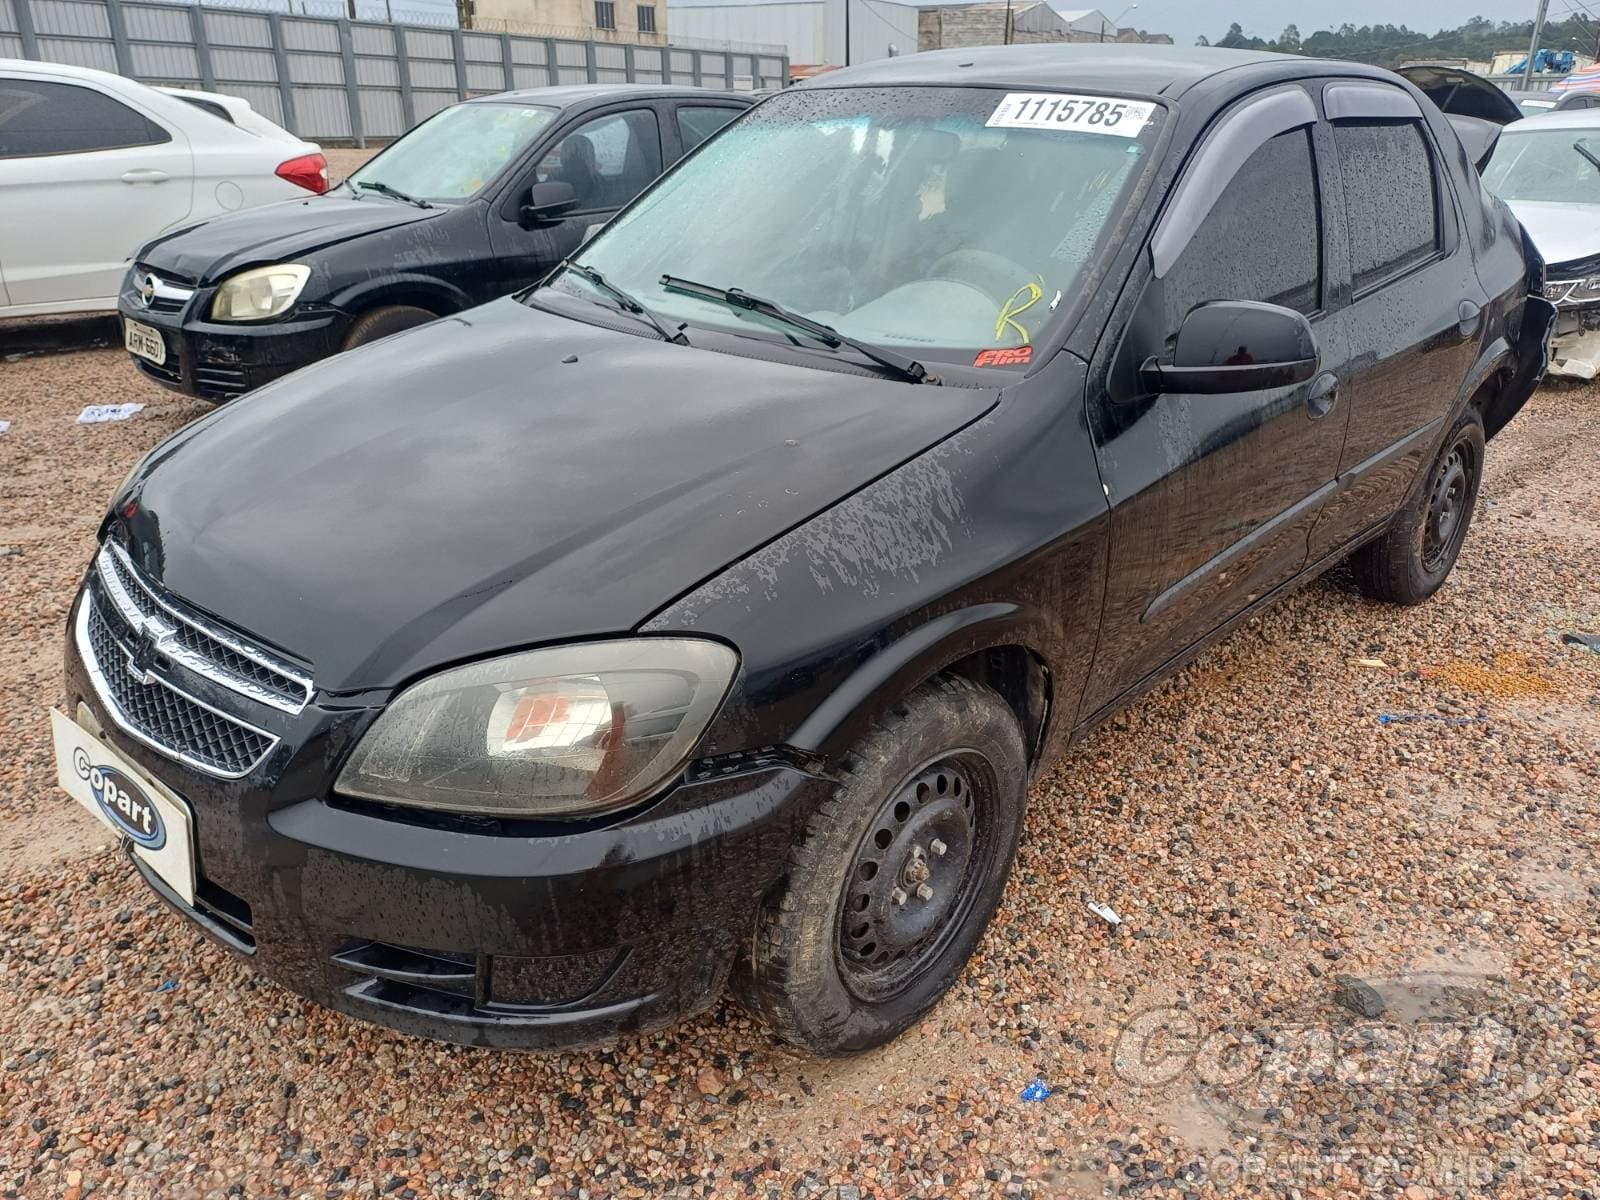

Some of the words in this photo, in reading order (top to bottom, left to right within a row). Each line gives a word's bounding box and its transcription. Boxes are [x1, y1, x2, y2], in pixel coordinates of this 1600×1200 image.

[1013, 97, 1128, 127] 1115785
[995, 282, 1042, 344] R
[73, 746, 153, 834] Copart
